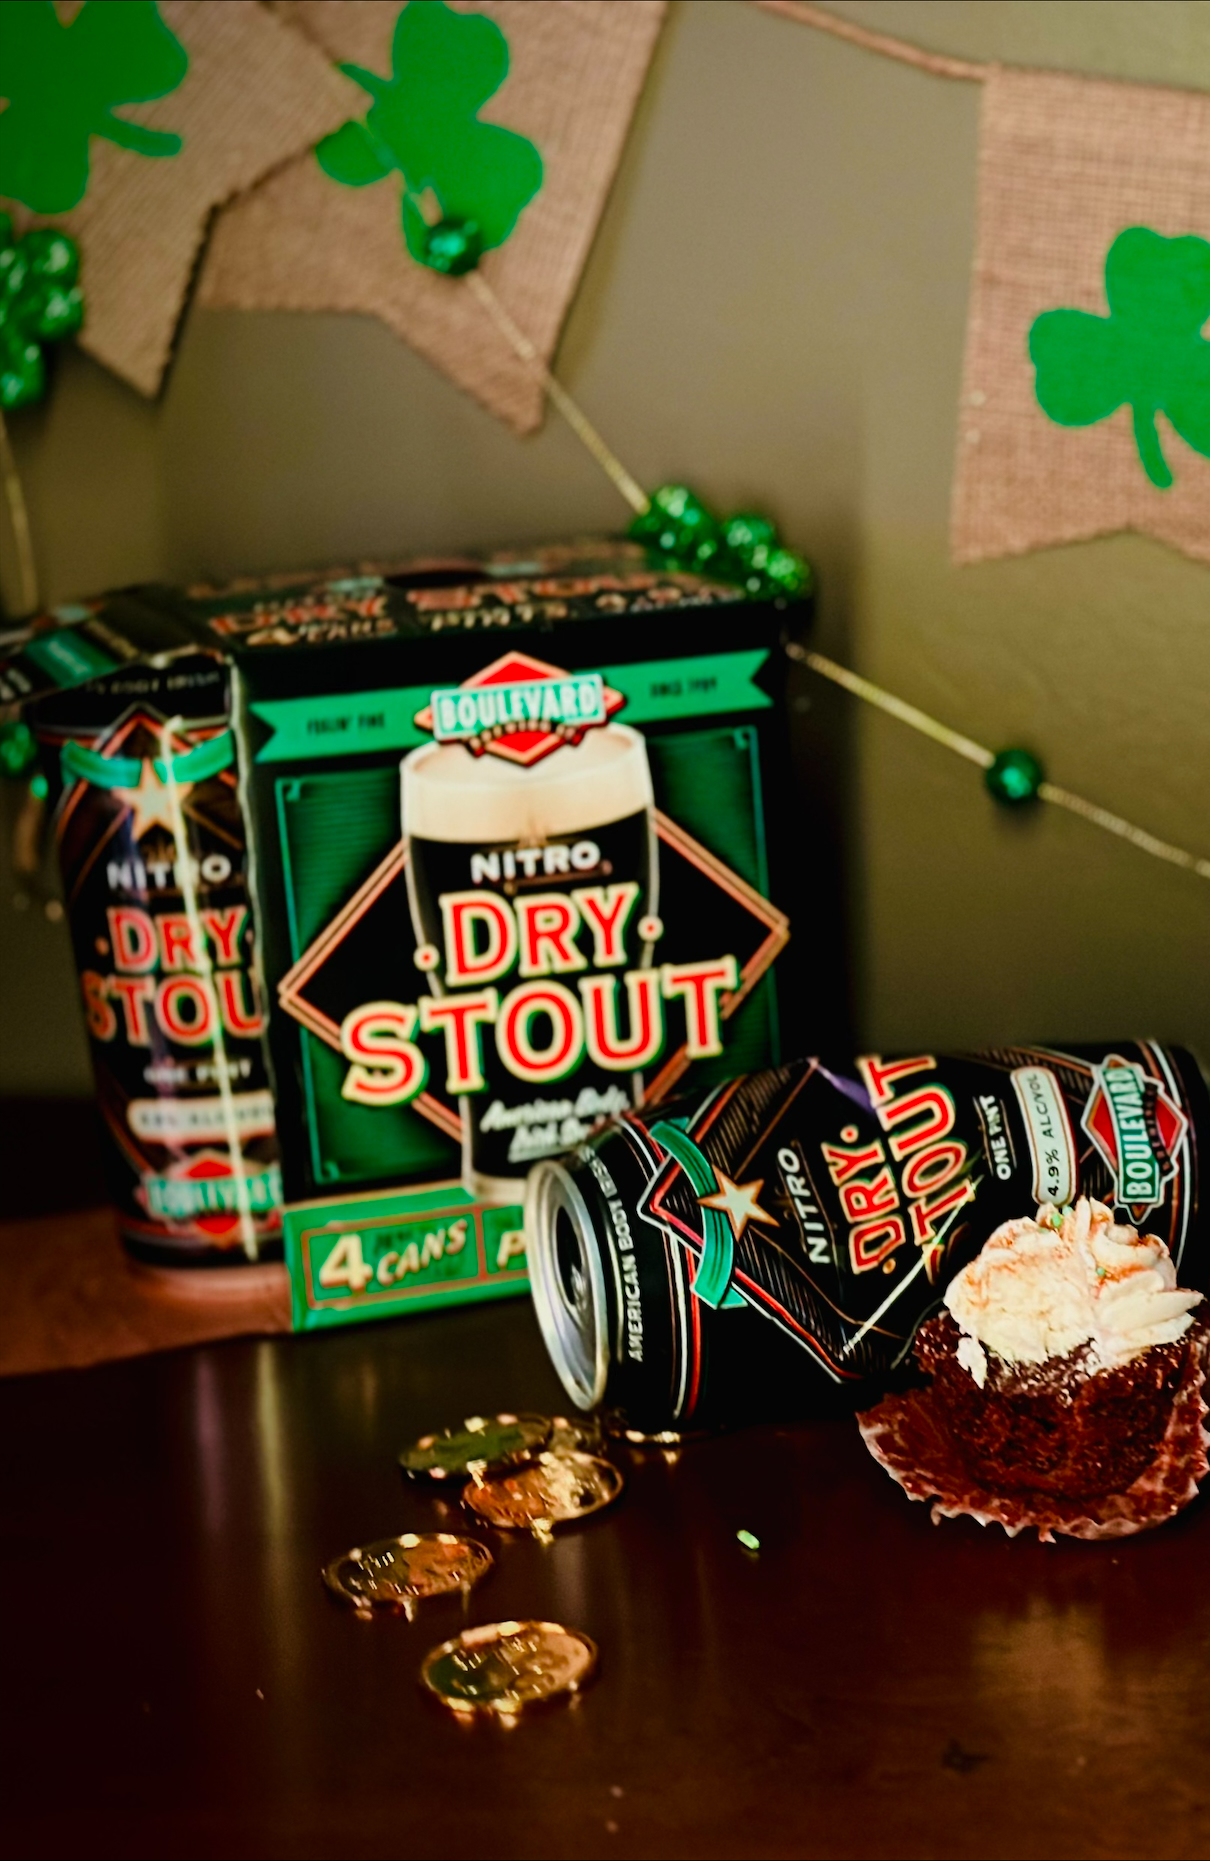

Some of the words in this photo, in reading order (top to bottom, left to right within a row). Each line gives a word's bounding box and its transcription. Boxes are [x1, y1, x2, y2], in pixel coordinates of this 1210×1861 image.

[440, 683, 597, 730] BOULEVARD
[470, 840, 602, 883] NITRO
[107, 903, 248, 975] DRY
[439, 883, 641, 987] DRY
[81, 968, 268, 1047] STOU
[340, 955, 742, 1108] STOUT
[979, 1094, 1003, 1136] PINT
[1027, 1074, 1055, 1139] ALC/VOL
[1104, 1070, 1154, 1196] BOULEVARD
[990, 1135, 1012, 1181] ONE
[1044, 1148, 1060, 1197] 4.9%
[608, 1199, 634, 1251] BODY
[777, 1148, 831, 1265] NITRO
[820, 1139, 906, 1275] DRY
[318, 1231, 375, 1292] 4
[375, 1217, 469, 1288] CANS
[621, 1253, 645, 1363] AMERICAN
